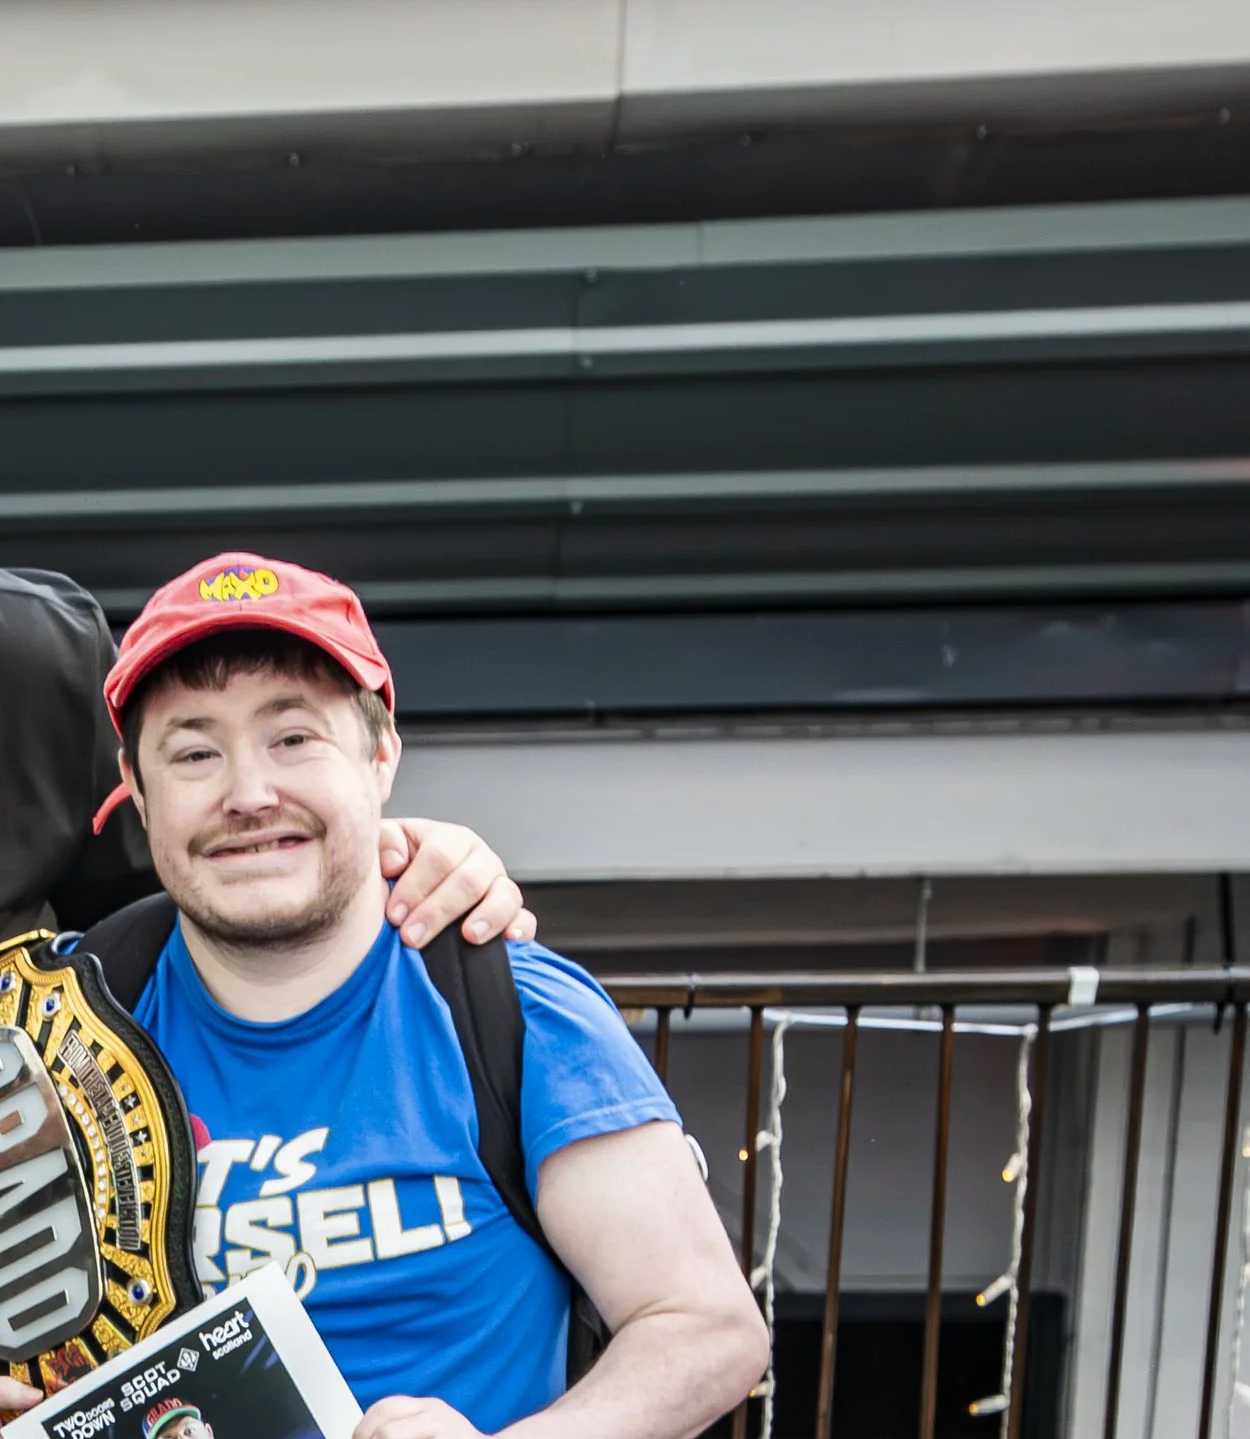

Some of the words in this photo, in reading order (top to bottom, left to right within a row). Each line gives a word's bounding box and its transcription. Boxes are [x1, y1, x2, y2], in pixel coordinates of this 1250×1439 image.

[198, 568, 279, 602] MAXO
[197, 1127, 329, 1206] T'S
[199, 1310, 249, 1352] heart
[212, 1329, 253, 1360] scotland
[119, 1368, 181, 1412] SQUAD
[120, 1361, 166, 1397] SCOT
[53, 1410, 87, 1439] TWO
[85, 1397, 116, 1422] DOORS
